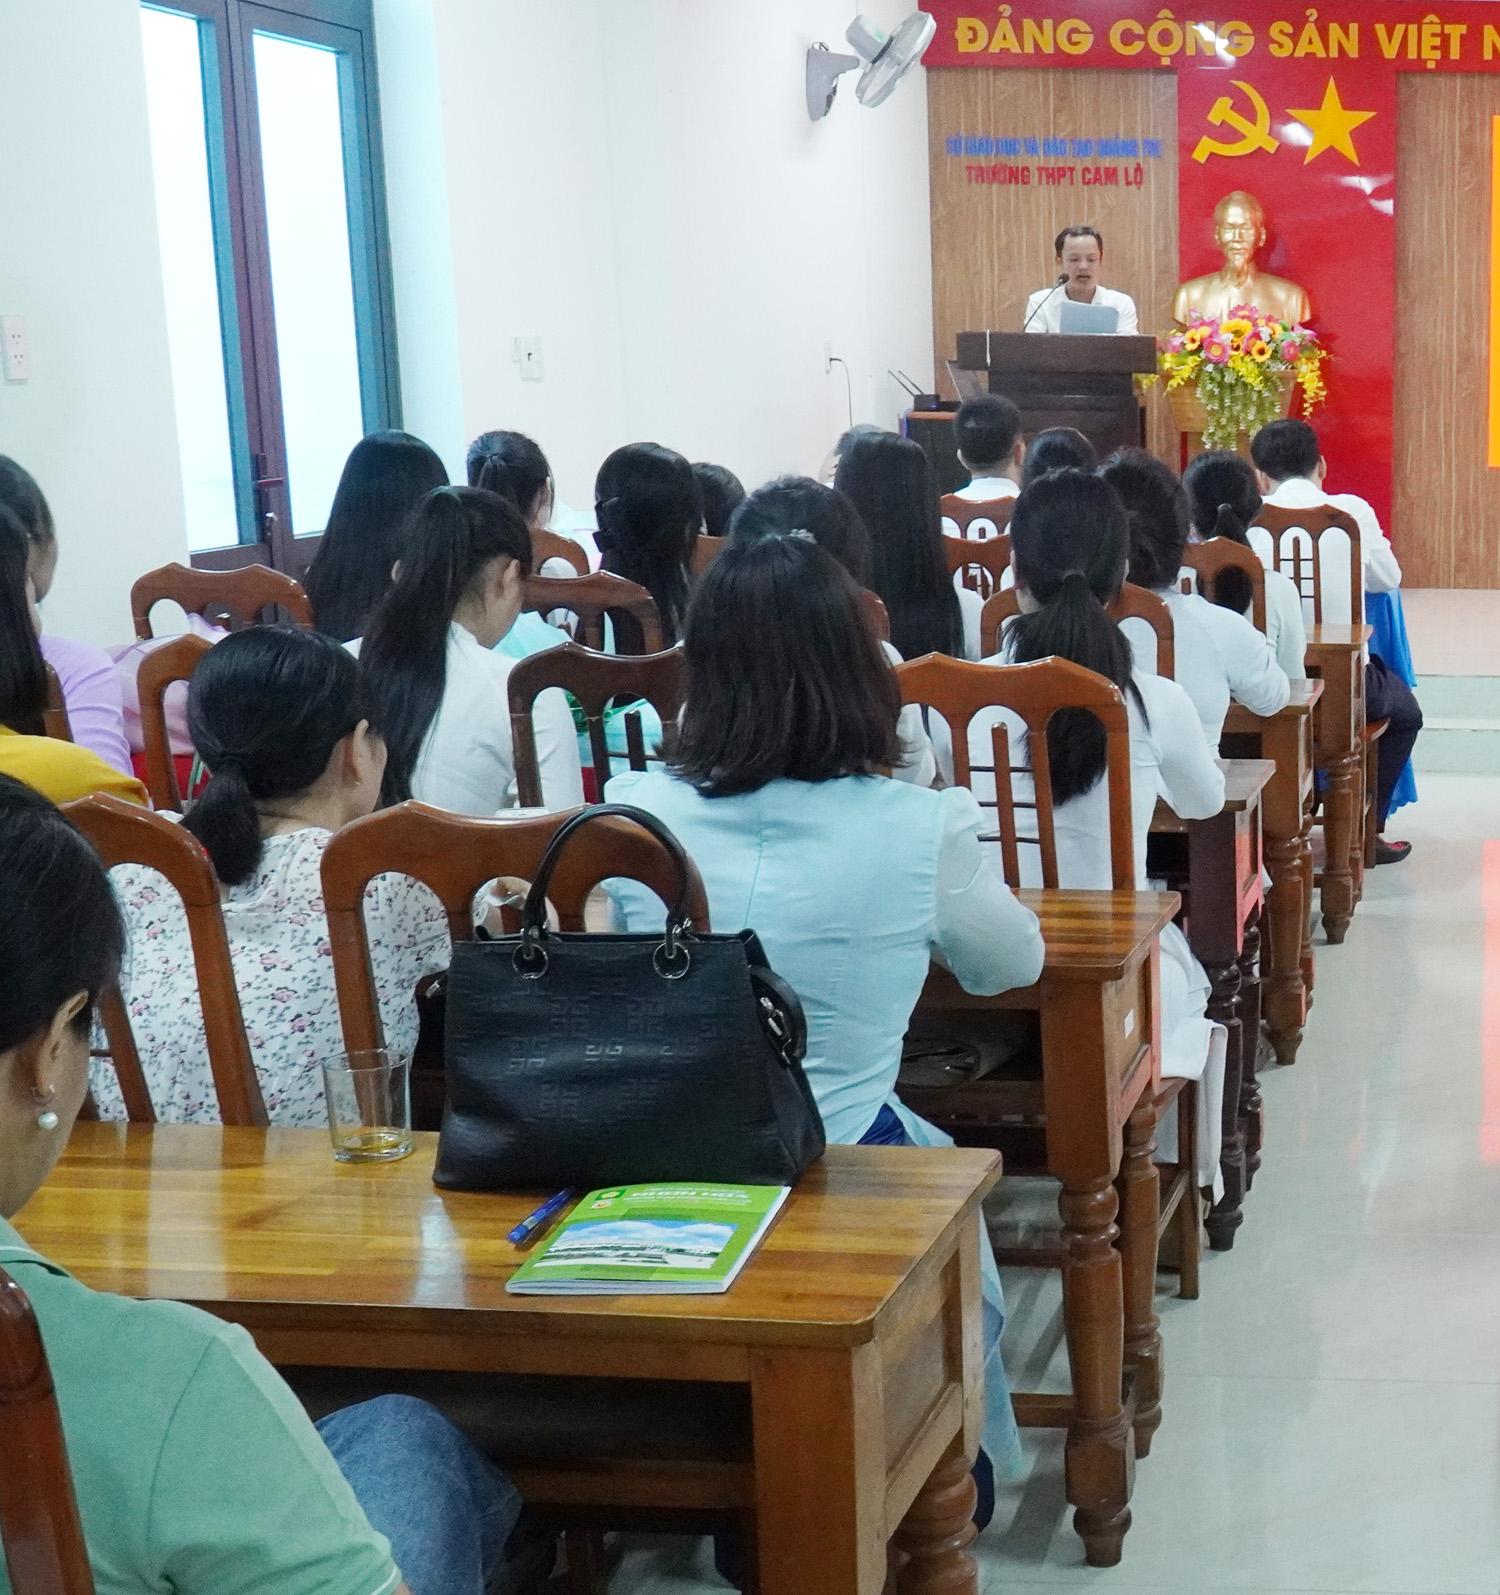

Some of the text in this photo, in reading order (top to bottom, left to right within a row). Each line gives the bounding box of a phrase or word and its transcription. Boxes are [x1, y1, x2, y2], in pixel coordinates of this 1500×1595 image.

[955, 5, 1094, 54] ĐẢNG
[1109, 9, 1256, 65] CỘNG
[1268, 8, 1360, 58] SẢN
[1375, 14, 1467, 68] VIỆT
[965, 161, 1032, 185] TRƯỜNG
[1035, 165, 1077, 186] THPT
[1080, 165, 1119, 187] CAM
